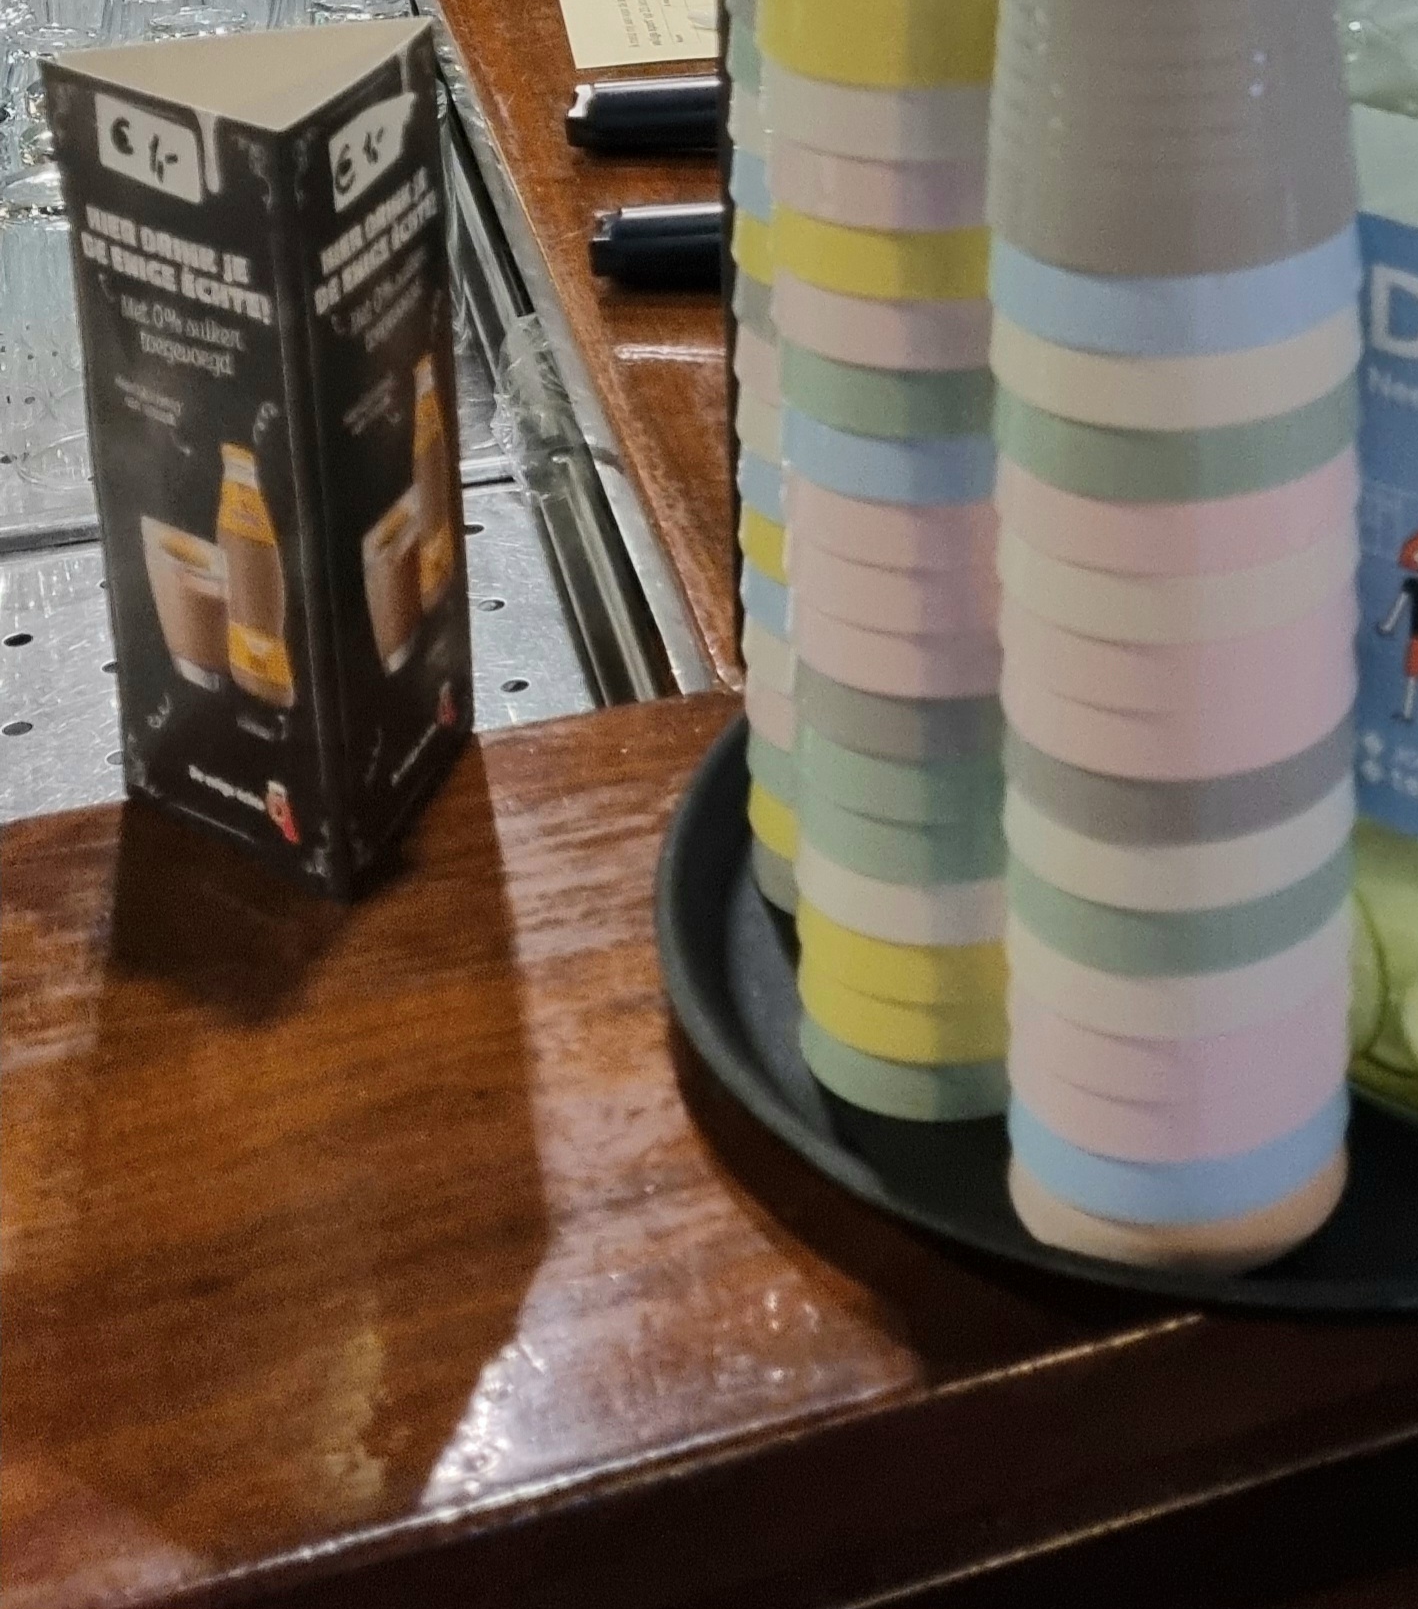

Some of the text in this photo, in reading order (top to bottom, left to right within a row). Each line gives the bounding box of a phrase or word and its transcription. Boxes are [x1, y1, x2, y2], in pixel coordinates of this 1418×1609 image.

[111, 116, 134, 156] €
[334, 143, 355, 195] €
[85, 203, 137, 247] HIER
[139, 224, 218, 276] DRINK
[110, 244, 178, 293] ENIGE
